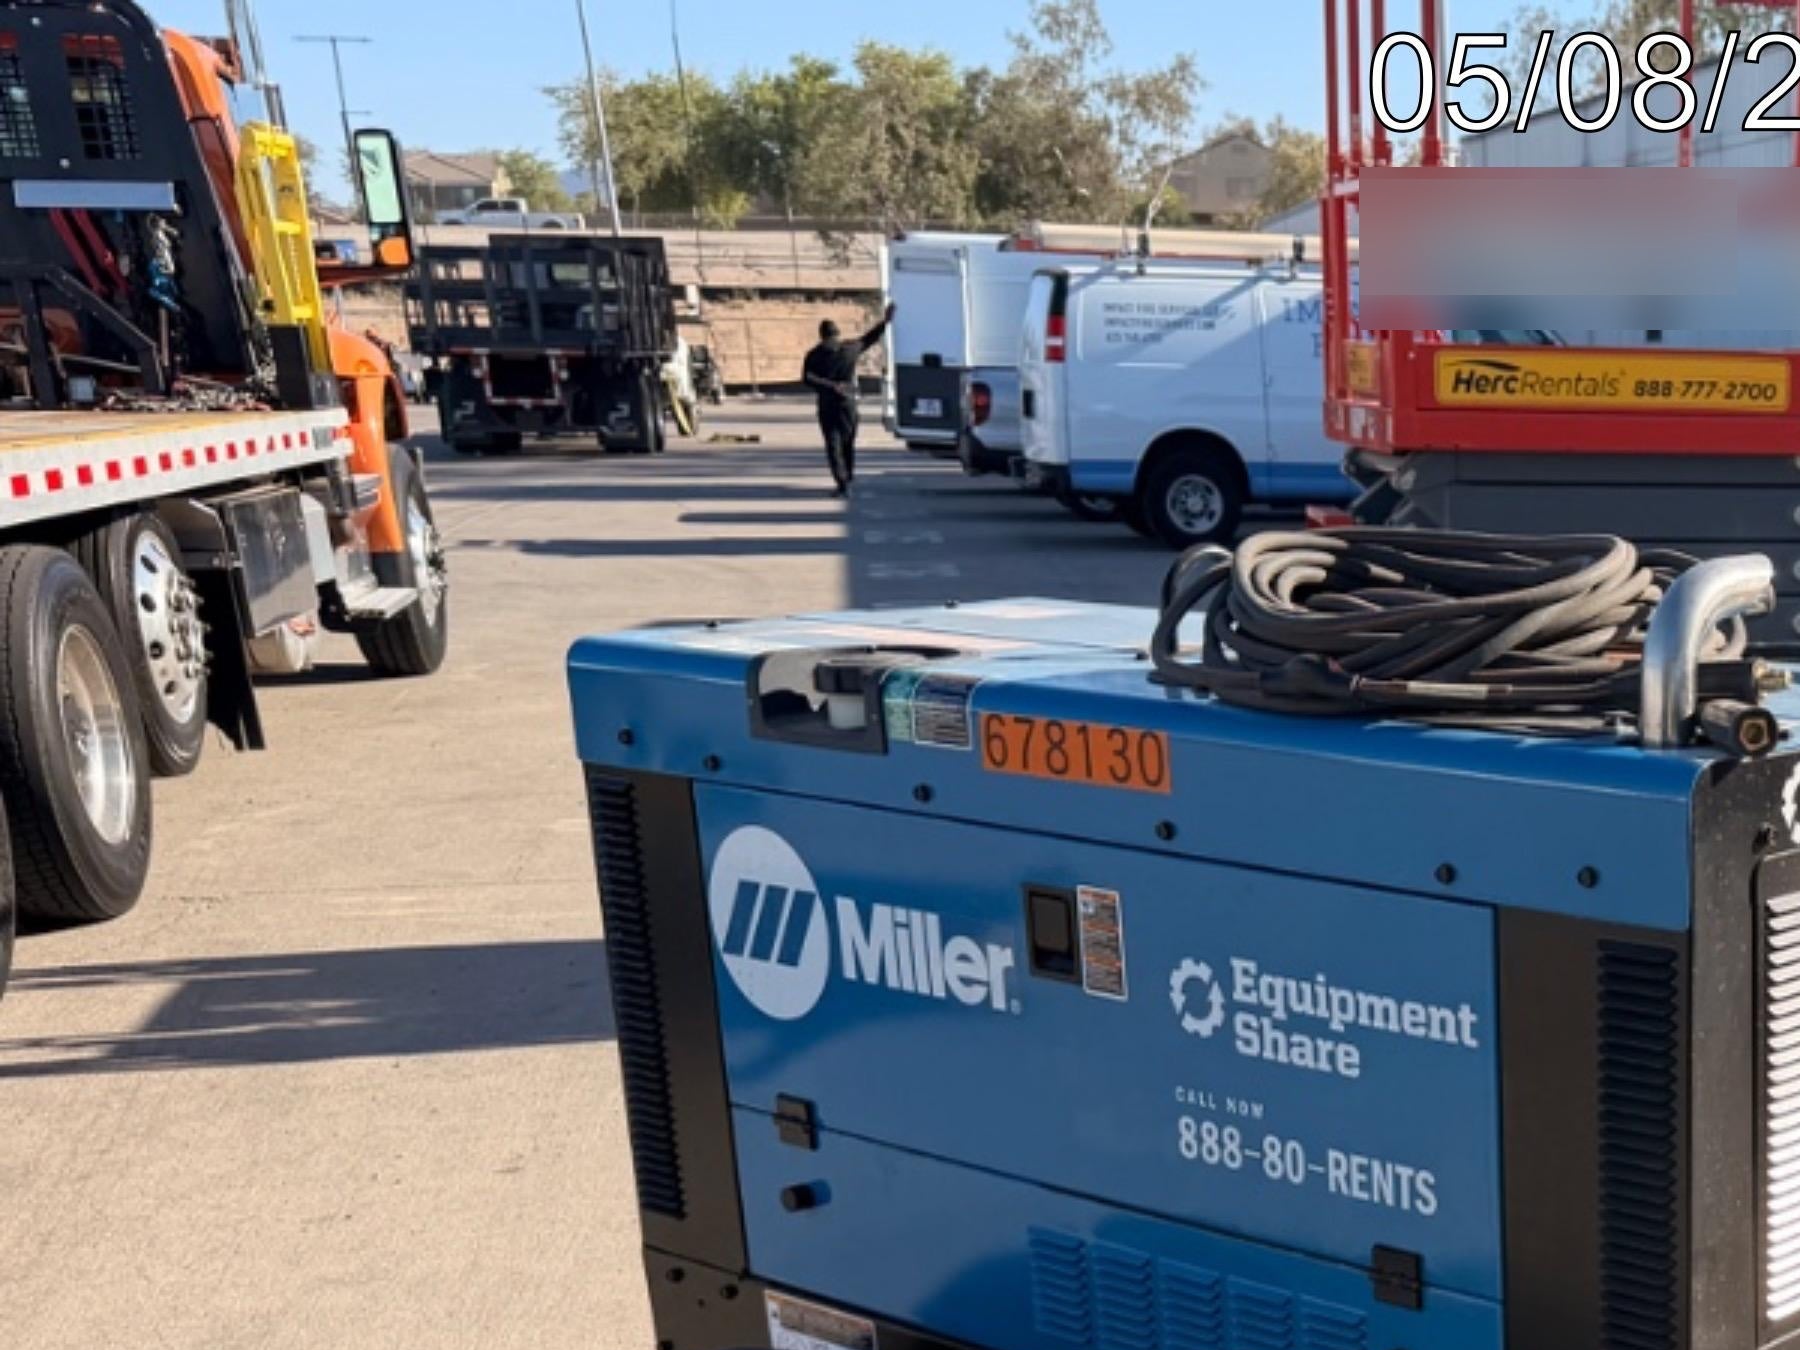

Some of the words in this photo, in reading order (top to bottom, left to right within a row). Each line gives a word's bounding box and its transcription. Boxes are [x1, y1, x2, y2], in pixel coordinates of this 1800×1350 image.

[1634, 379, 1777, 402] 888-777-2700
[985, 714, 1165, 787] 678130
[834, 895, 1014, 1012] Miller
[1229, 956, 1480, 1048] Equipment
[1233, 1011, 1361, 1078] Share
[1175, 1085, 1216, 1111] CALL
[1225, 1097, 1264, 1120] NOW
[1177, 1115, 1439, 1216] 888-80-RENTS
